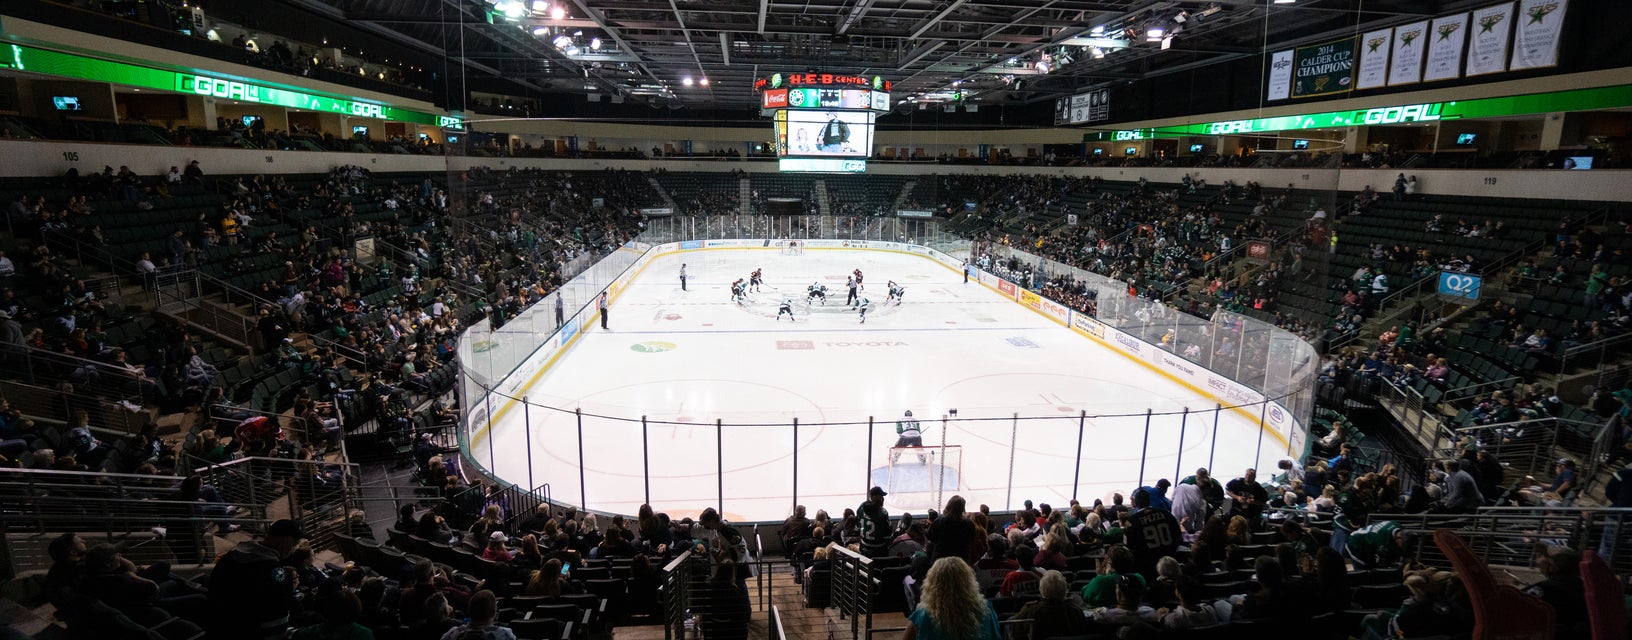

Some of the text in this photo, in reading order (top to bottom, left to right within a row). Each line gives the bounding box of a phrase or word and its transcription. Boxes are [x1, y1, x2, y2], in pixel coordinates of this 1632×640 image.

[1301, 54, 1331, 67] CALDER
[1333, 50, 1351, 61] CUP
[1317, 44, 1334, 56] 2014
[1297, 59, 1353, 77] CHAMPIONS
[789, 73, 868, 85] H-E-B CENTER
[193, 75, 259, 103] GOAL
[352, 102, 387, 119] GOAL
[1364, 103, 1441, 125] GOAL
[1210, 120, 1254, 135] GOAL
[63, 152, 79, 162] 105
[1484, 177, 1497, 185] 119
[1446, 274, 1474, 293] Q2
[1142, 522, 1173, 550] 90
